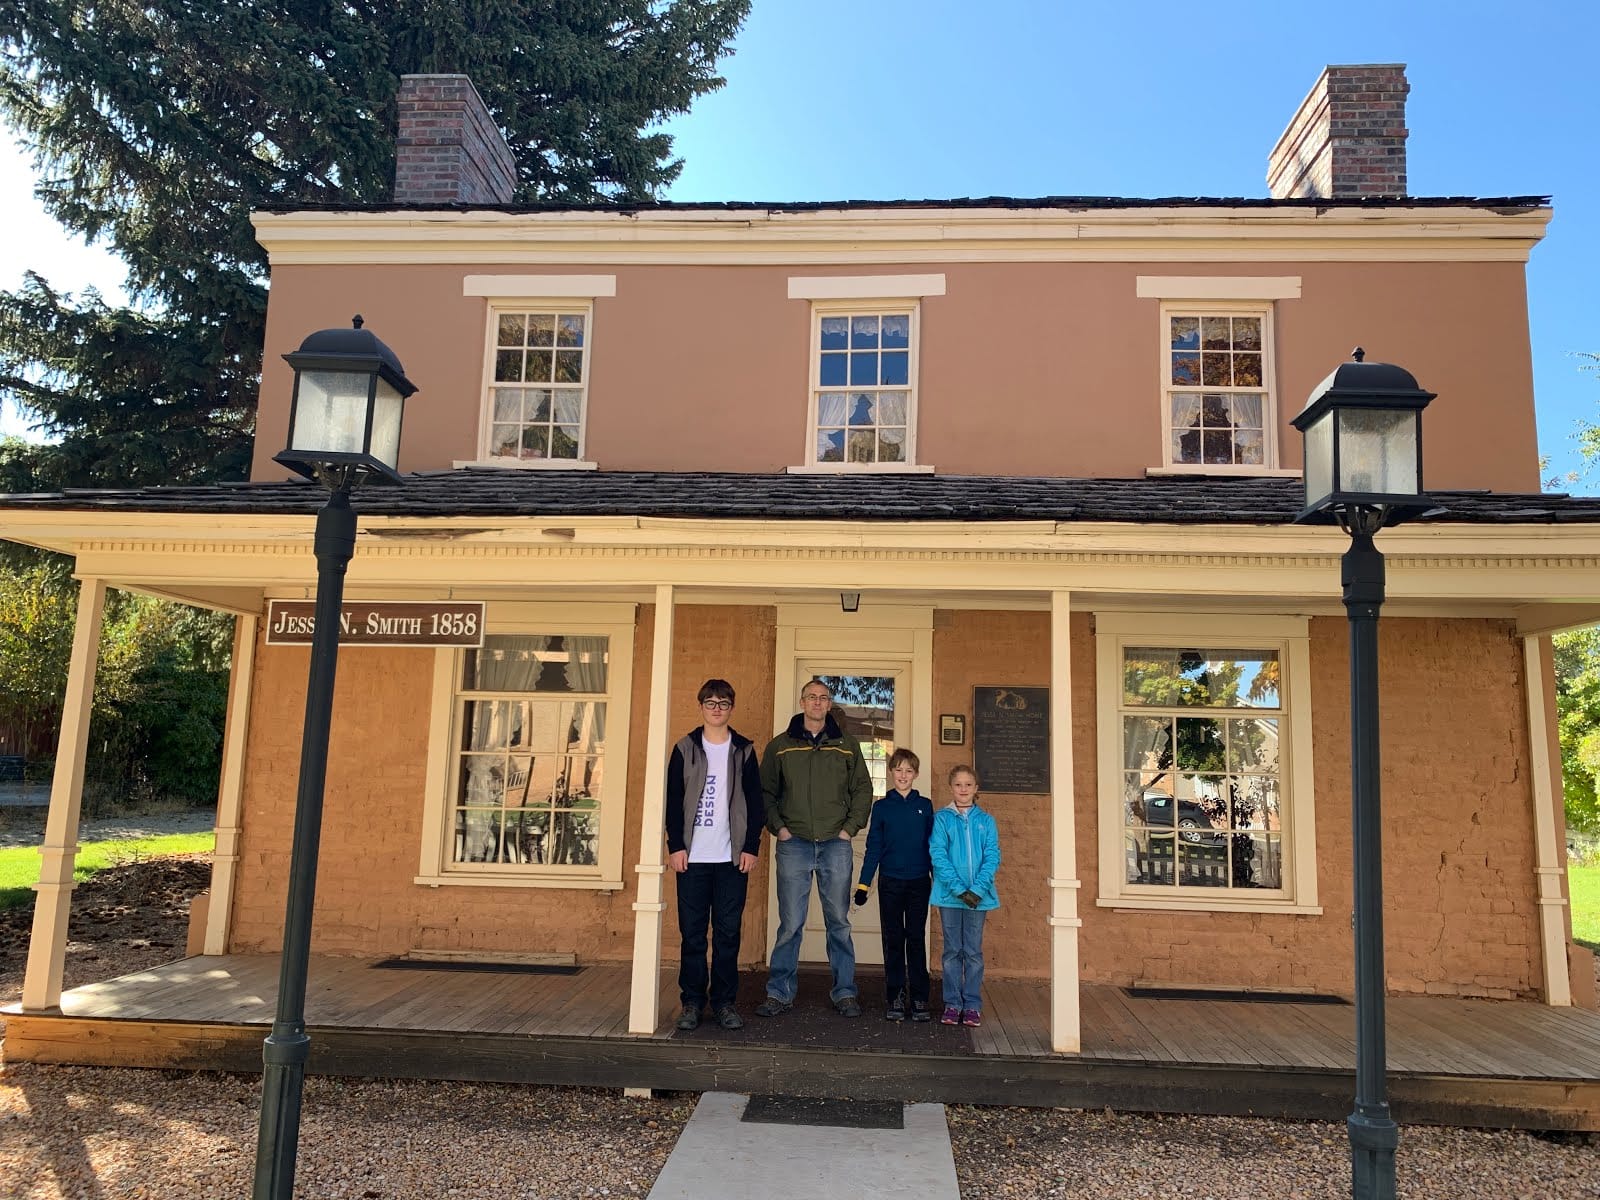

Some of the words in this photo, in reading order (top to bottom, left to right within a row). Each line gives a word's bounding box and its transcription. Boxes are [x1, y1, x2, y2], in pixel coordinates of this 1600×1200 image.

[274, 611, 316, 634] JESS
[366, 612, 422, 635] SMITH
[430, 613, 477, 636] 1858
